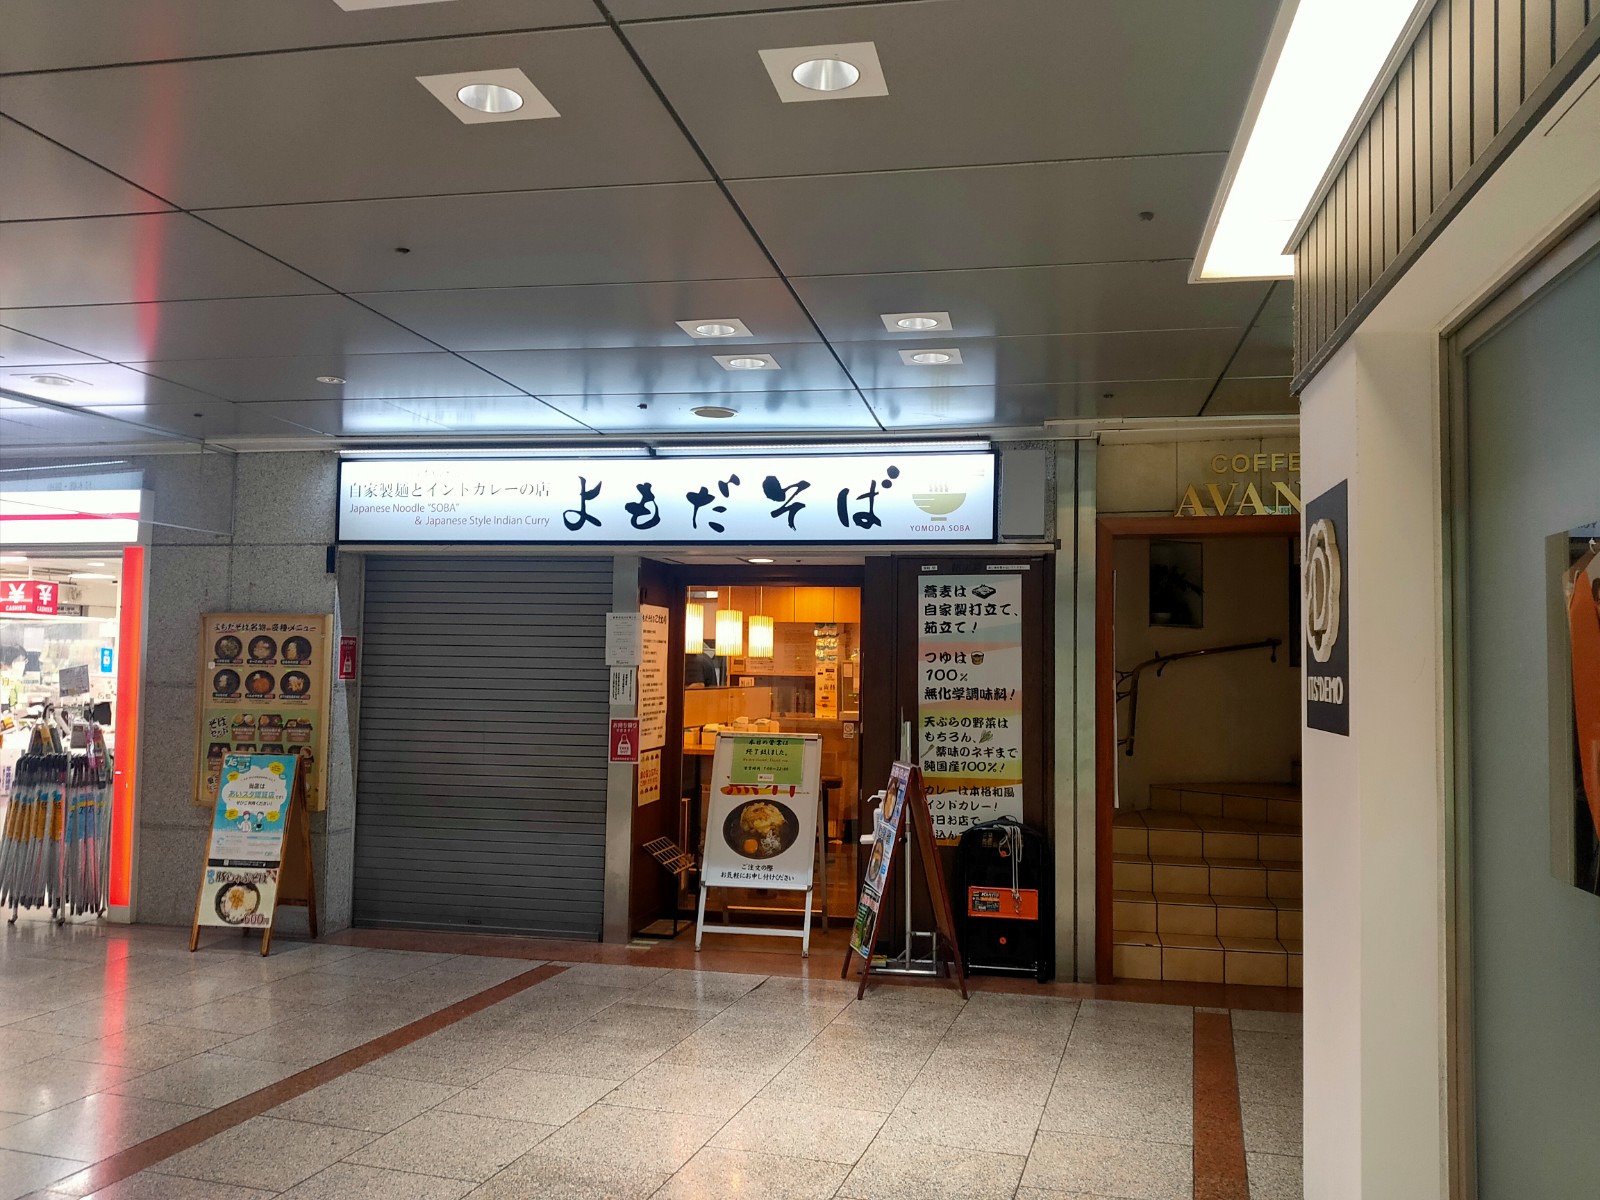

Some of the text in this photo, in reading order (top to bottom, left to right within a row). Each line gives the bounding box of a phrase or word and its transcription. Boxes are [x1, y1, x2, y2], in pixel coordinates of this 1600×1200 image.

[562, 465, 900, 532] よもだそば
[350, 504, 391, 515] Japanese
[392, 503, 425, 513] Noodle
[414, 515, 550, 527] & Japanese Style Indian Curry
[910, 524, 971, 532] YOMODA SOBA
[924, 585, 967, 598] 蕎麦は
[5, 604, 27, 612] CASHIER
[924, 651, 967, 664] つゆは
[926, 669, 968, 681] 100%
[925, 785, 1015, 798] カレーは本格和風
